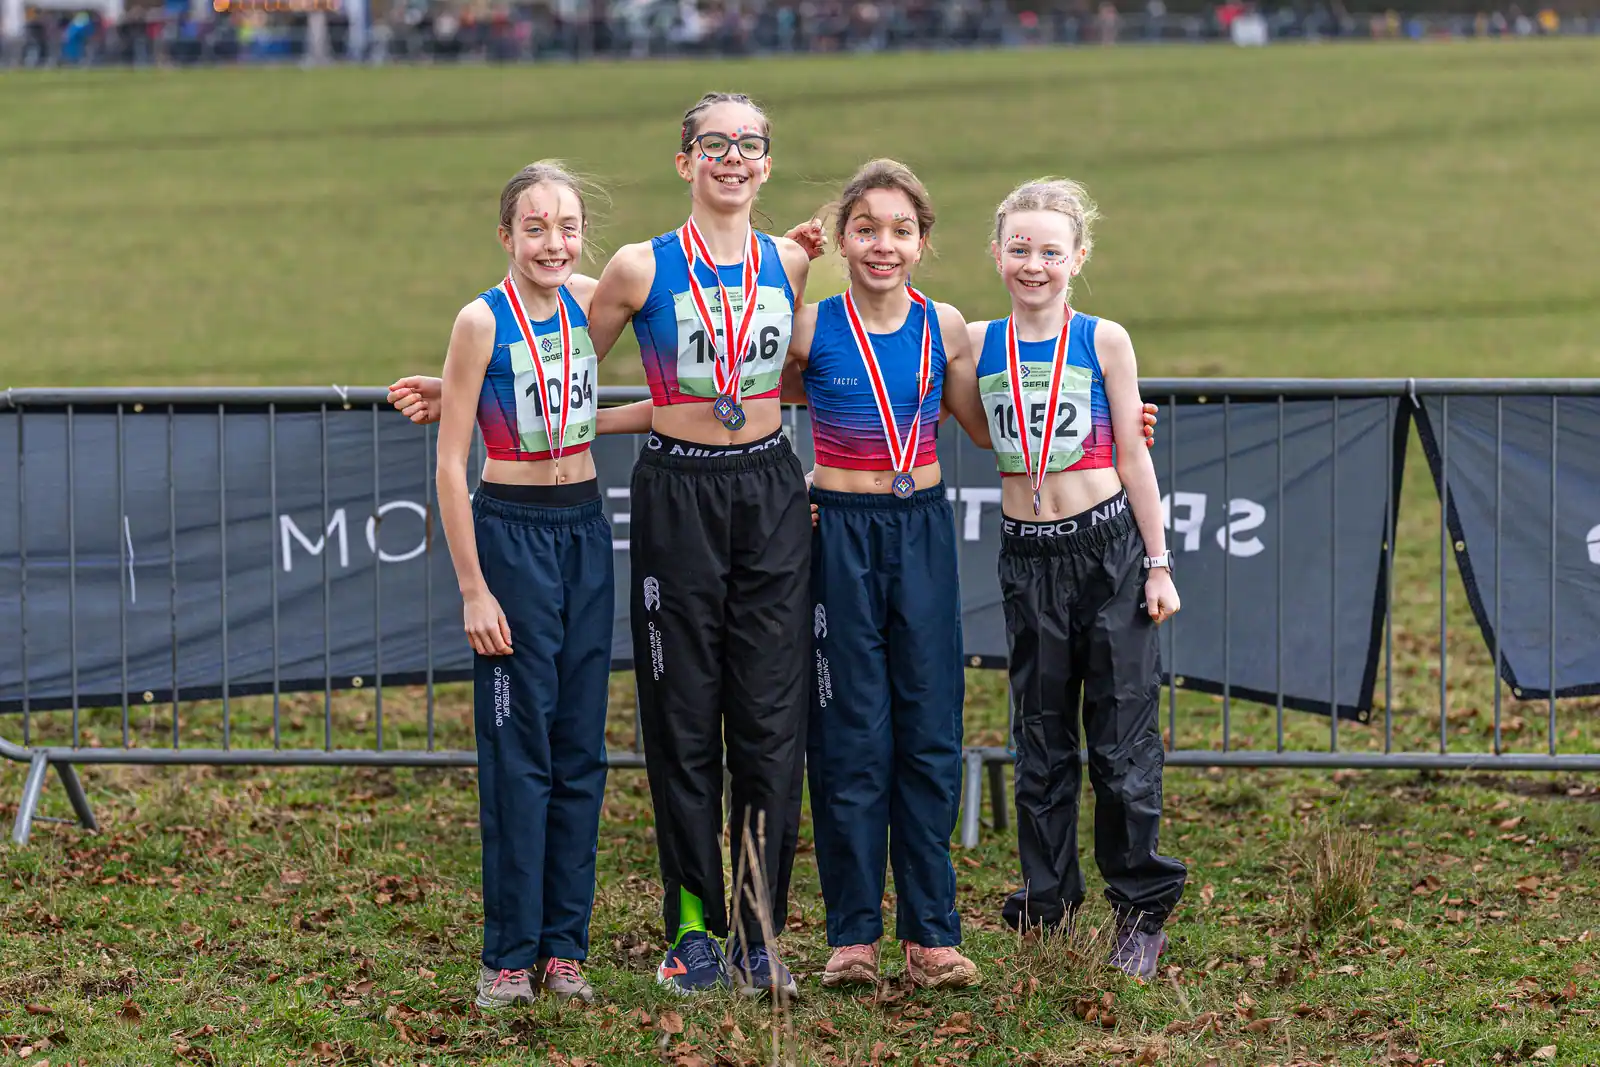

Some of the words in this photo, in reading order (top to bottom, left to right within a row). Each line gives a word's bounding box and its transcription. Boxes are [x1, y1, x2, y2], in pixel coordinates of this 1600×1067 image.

[541, 348, 580, 363] EDGELD
[744, 379, 756, 387] RUN
[833, 377, 858, 386] TACTIC
[1002, 380, 1065, 389] SGEFIE
[995, 401, 1077, 438] 1052
[1020, 519, 1078, 538] PRO
[1091, 488, 1128, 527] NIK
[648, 621, 655, 632] OF
[656, 630, 665, 673] CANTERBURY
[815, 648, 822, 659] OF
[494, 666, 502, 677] OF
[651, 648, 660, 681] ZEALAND
[494, 678, 502, 694] NEW
[822, 657, 833, 700] CANTERBURY
[502, 674, 511, 718] CANTERBURY
[818, 675, 827, 708] ZEALAND
[494, 694, 504, 727] ZEALAND
